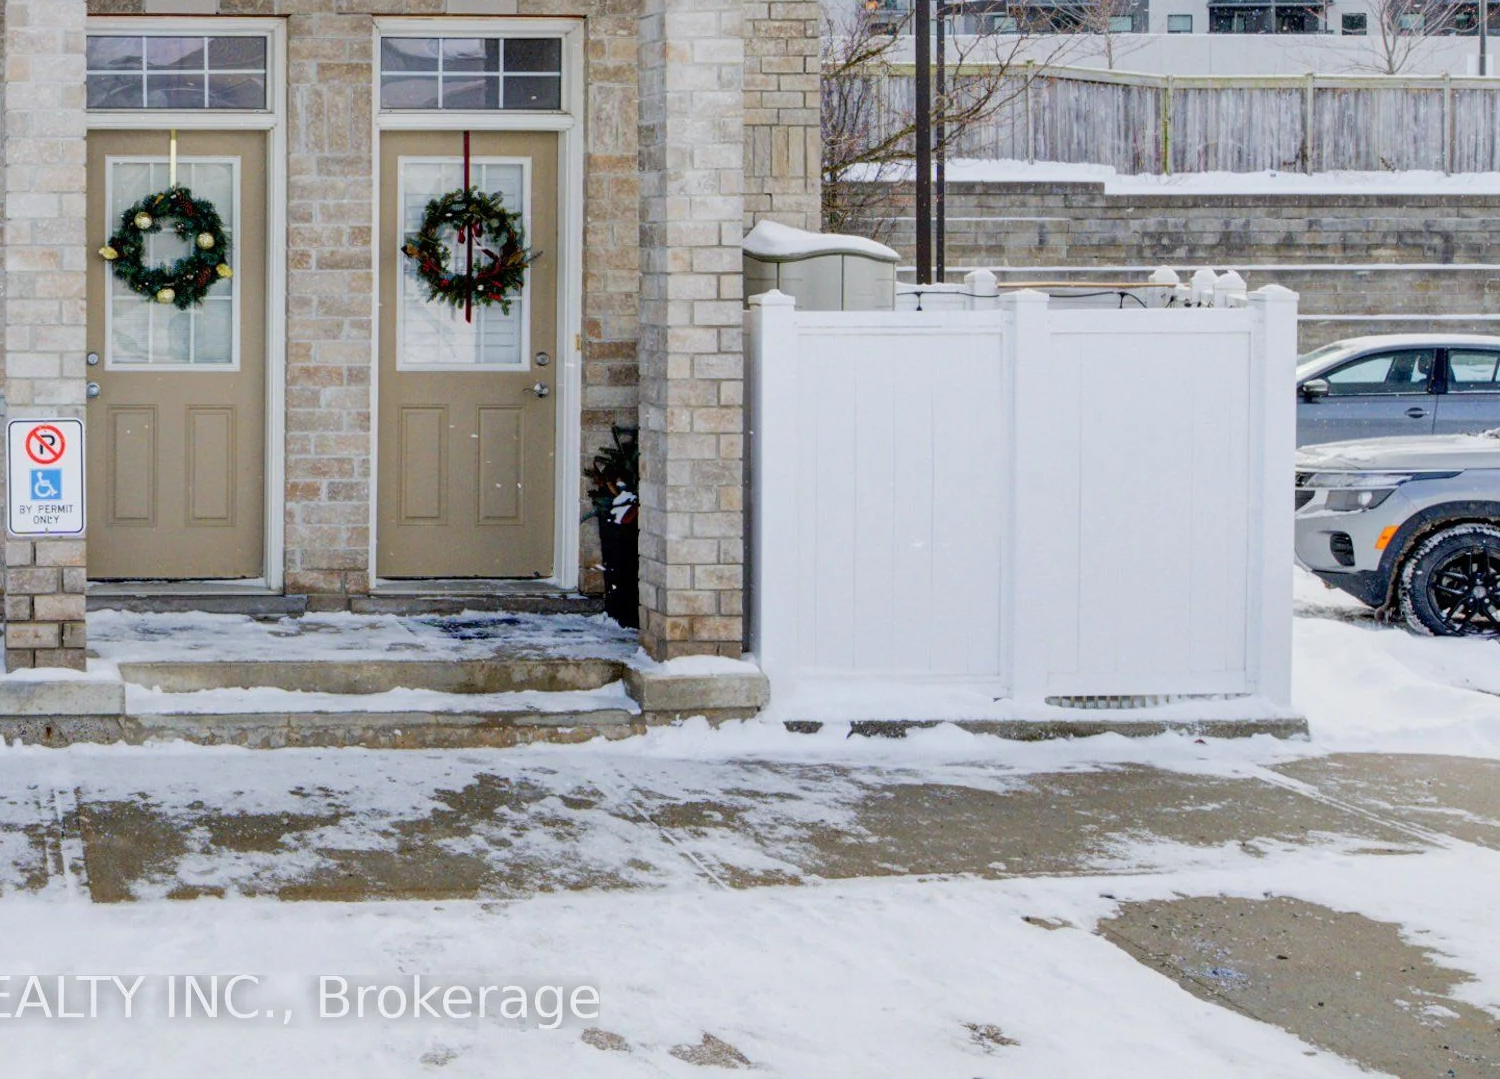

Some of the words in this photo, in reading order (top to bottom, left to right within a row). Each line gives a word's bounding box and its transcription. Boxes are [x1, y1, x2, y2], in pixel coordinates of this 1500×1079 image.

[19, 505, 33, 514] BY
[38, 504, 73, 514] PERMIT
[33, 515, 60, 524] ONLY
